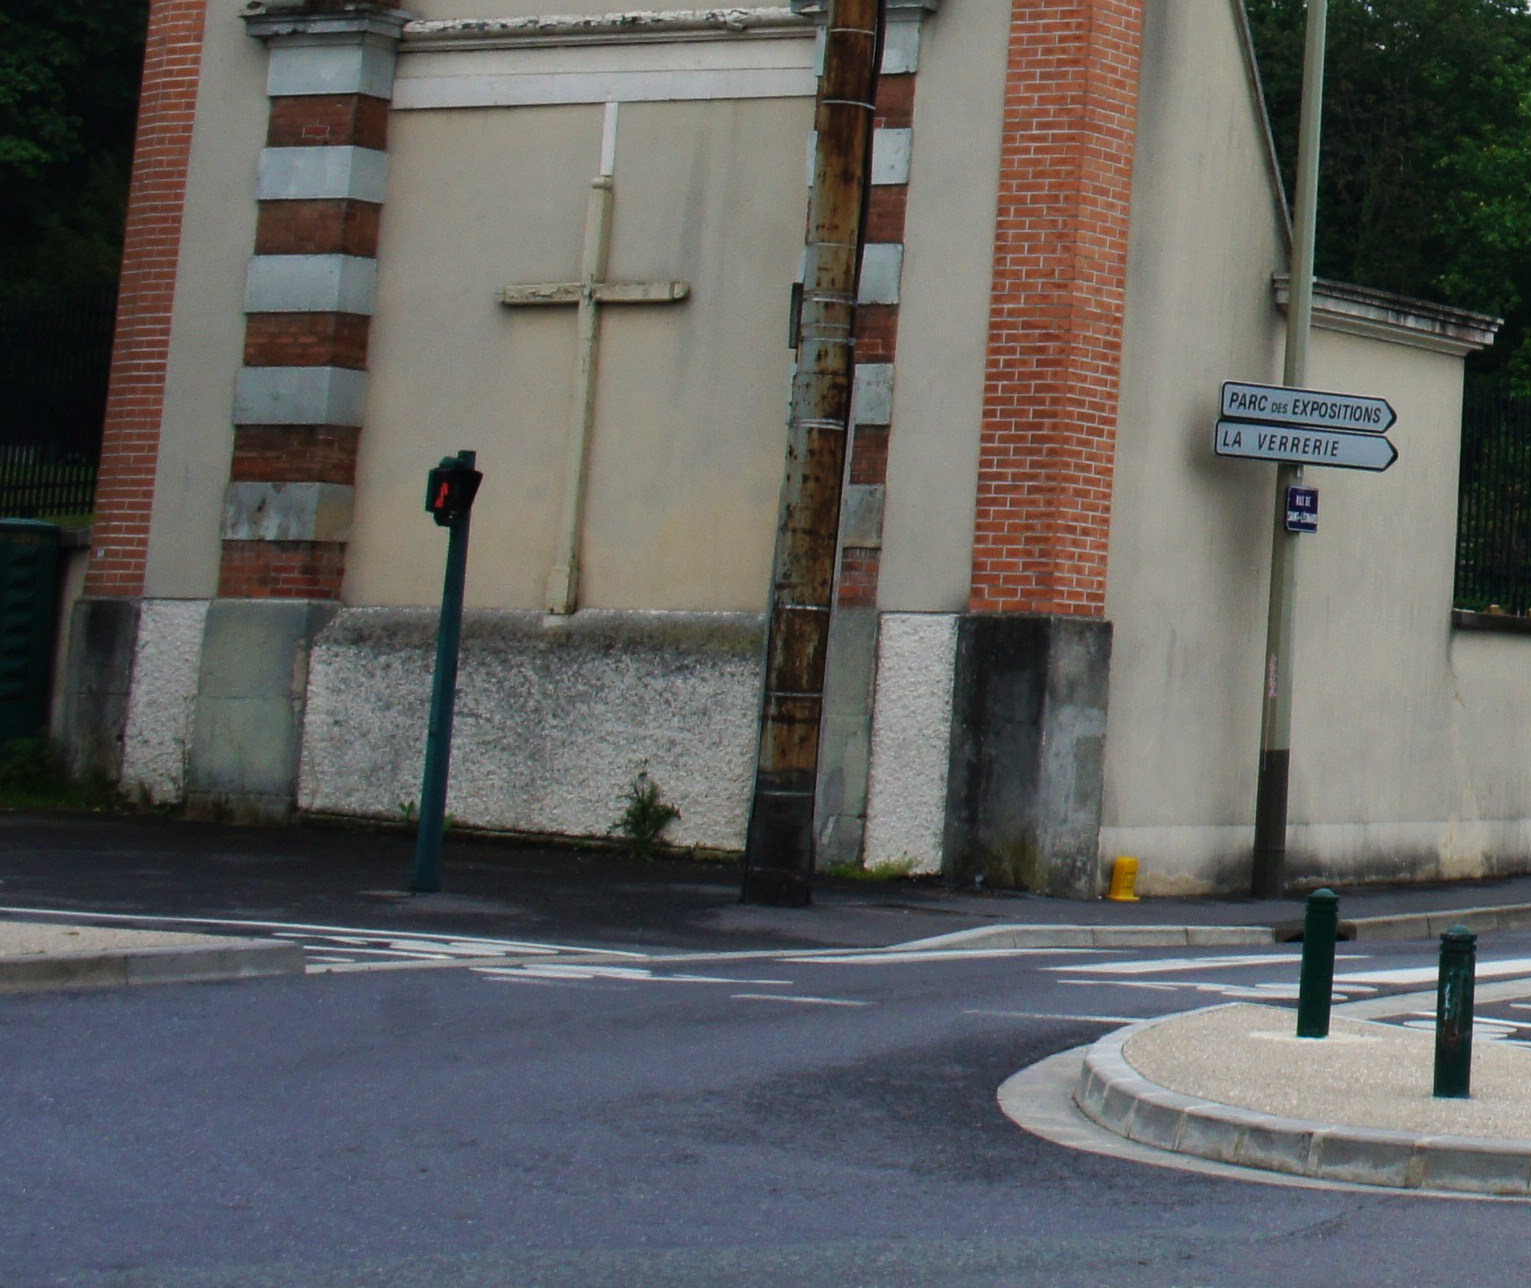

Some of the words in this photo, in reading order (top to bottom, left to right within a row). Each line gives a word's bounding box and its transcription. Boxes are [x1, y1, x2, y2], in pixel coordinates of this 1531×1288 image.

[1228, 392, 1268, 412] PARC
[1271, 402, 1288, 414] DES
[1291, 399, 1382, 424] EXPOSITIONS
[1222, 430, 1242, 448] LA
[1258, 433, 1339, 457] VERRERIE
